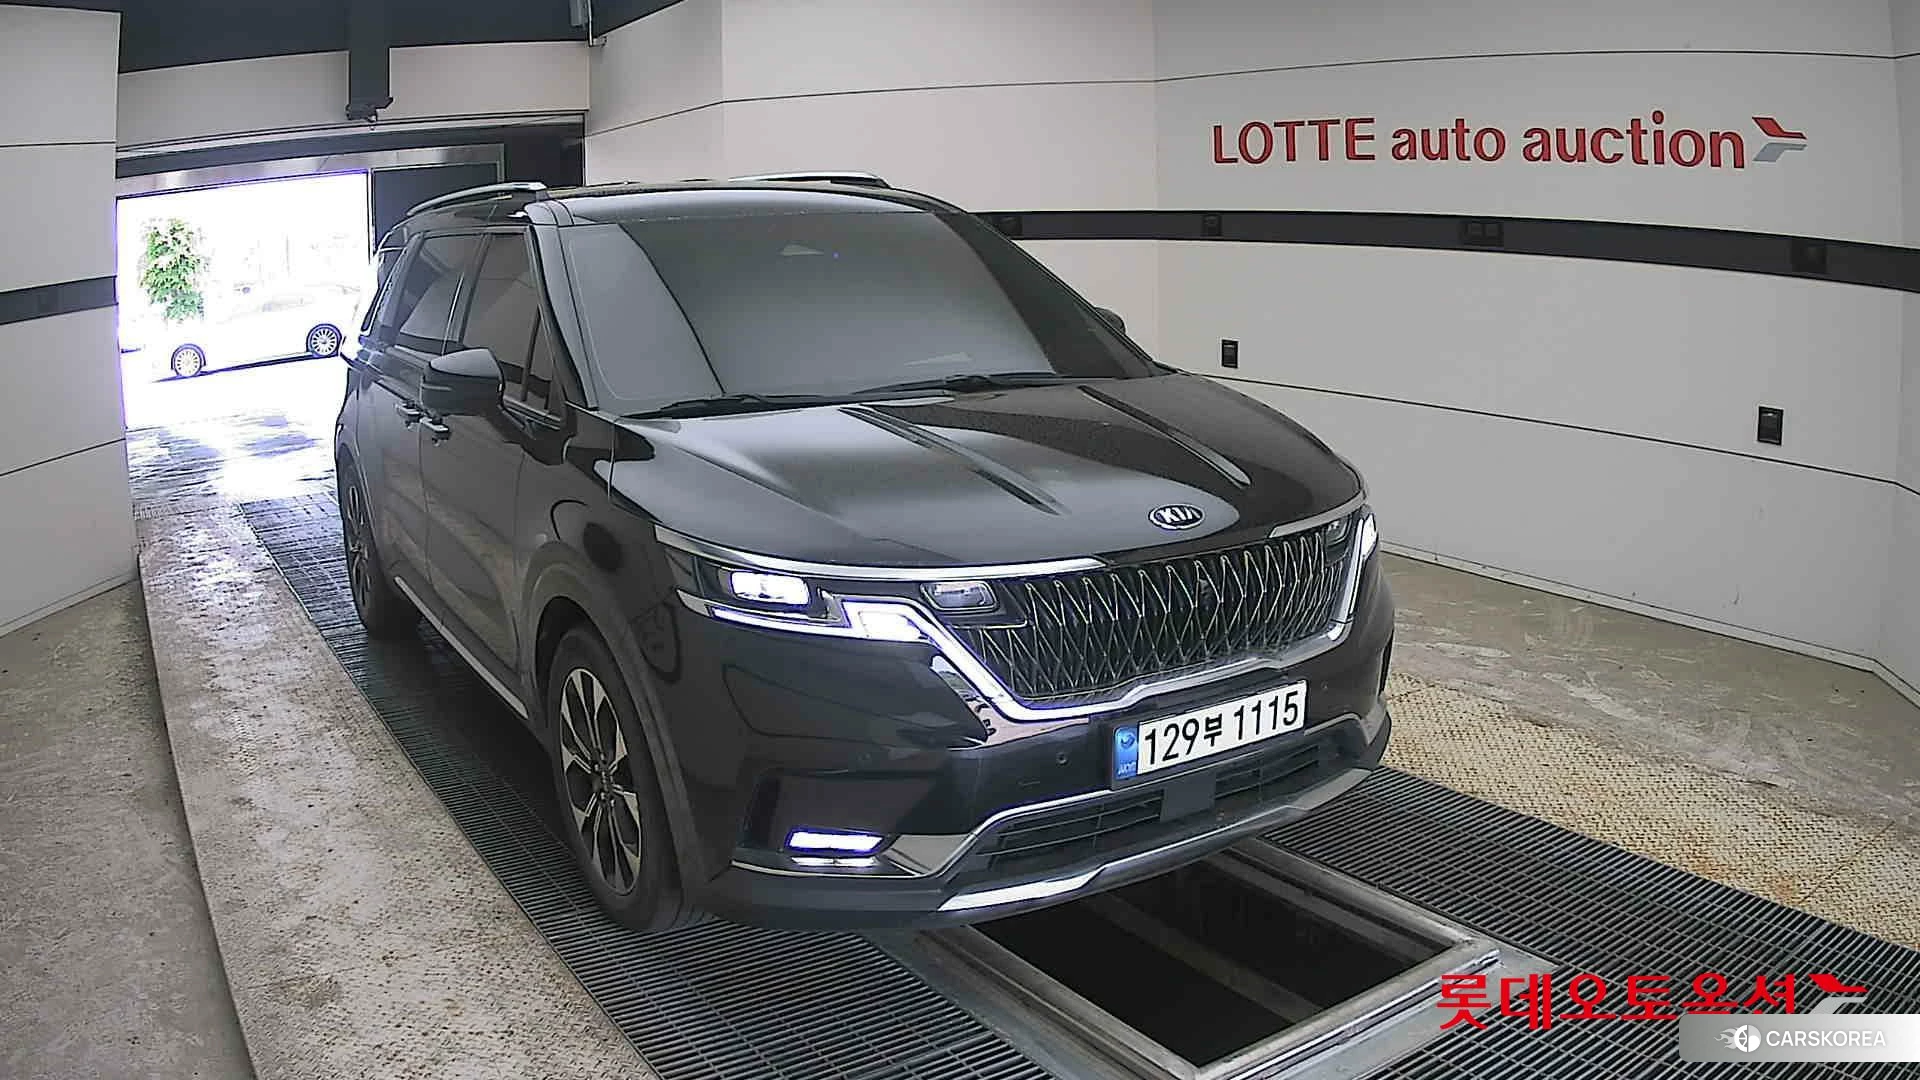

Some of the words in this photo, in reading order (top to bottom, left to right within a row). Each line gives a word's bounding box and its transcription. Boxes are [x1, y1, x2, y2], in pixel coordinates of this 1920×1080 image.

[1213, 117, 1376, 164] LOTTE
[1391, 118, 1506, 162] auto
[1522, 110, 1745, 169] auction
[1153, 506, 1202, 525] KIA
[1144, 713, 1223, 766] 129부
[1234, 690, 1299, 741] 1115
